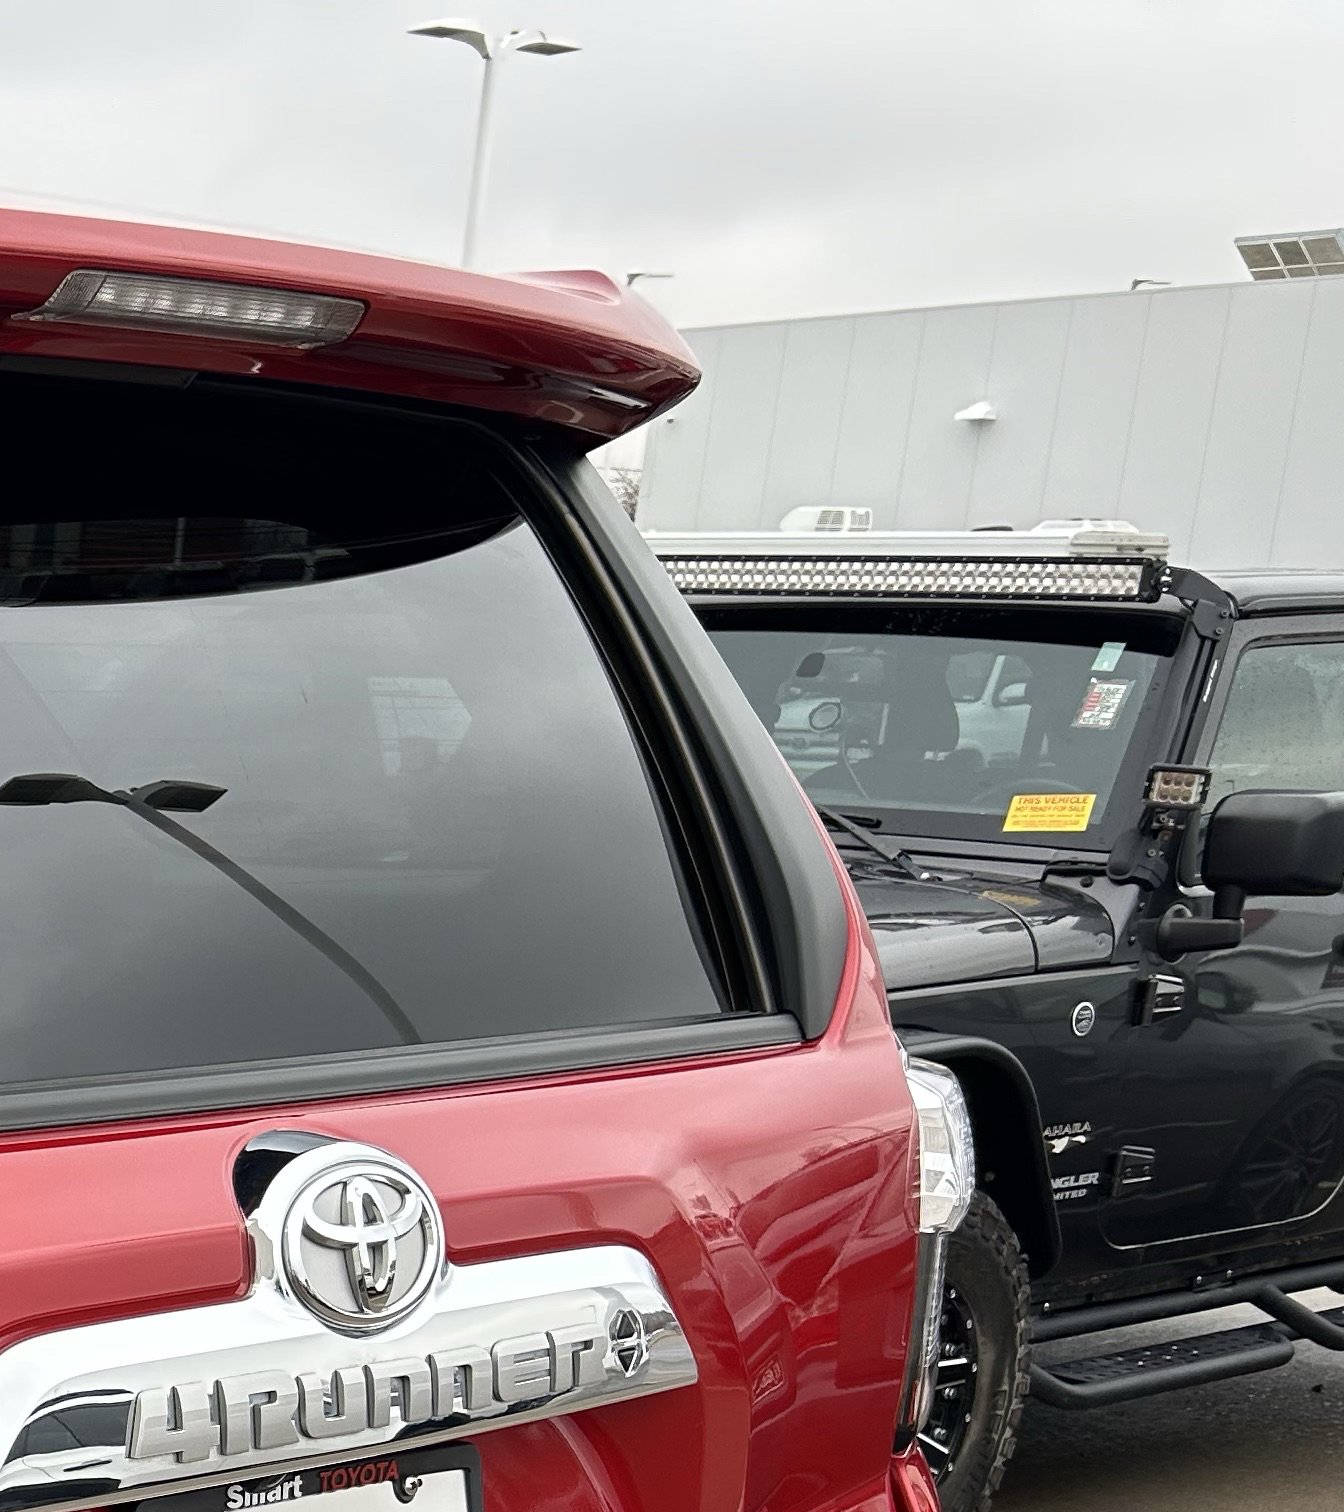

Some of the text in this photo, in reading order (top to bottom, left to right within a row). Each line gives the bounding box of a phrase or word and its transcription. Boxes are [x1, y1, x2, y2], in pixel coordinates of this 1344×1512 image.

[1045, 796, 1089, 804] VEHICLE
[1043, 1121, 1091, 1137] AHARA
[1051, 1172, 1099, 1189] NGLER
[227, 1461, 399, 1509] Smart TOYOTA
